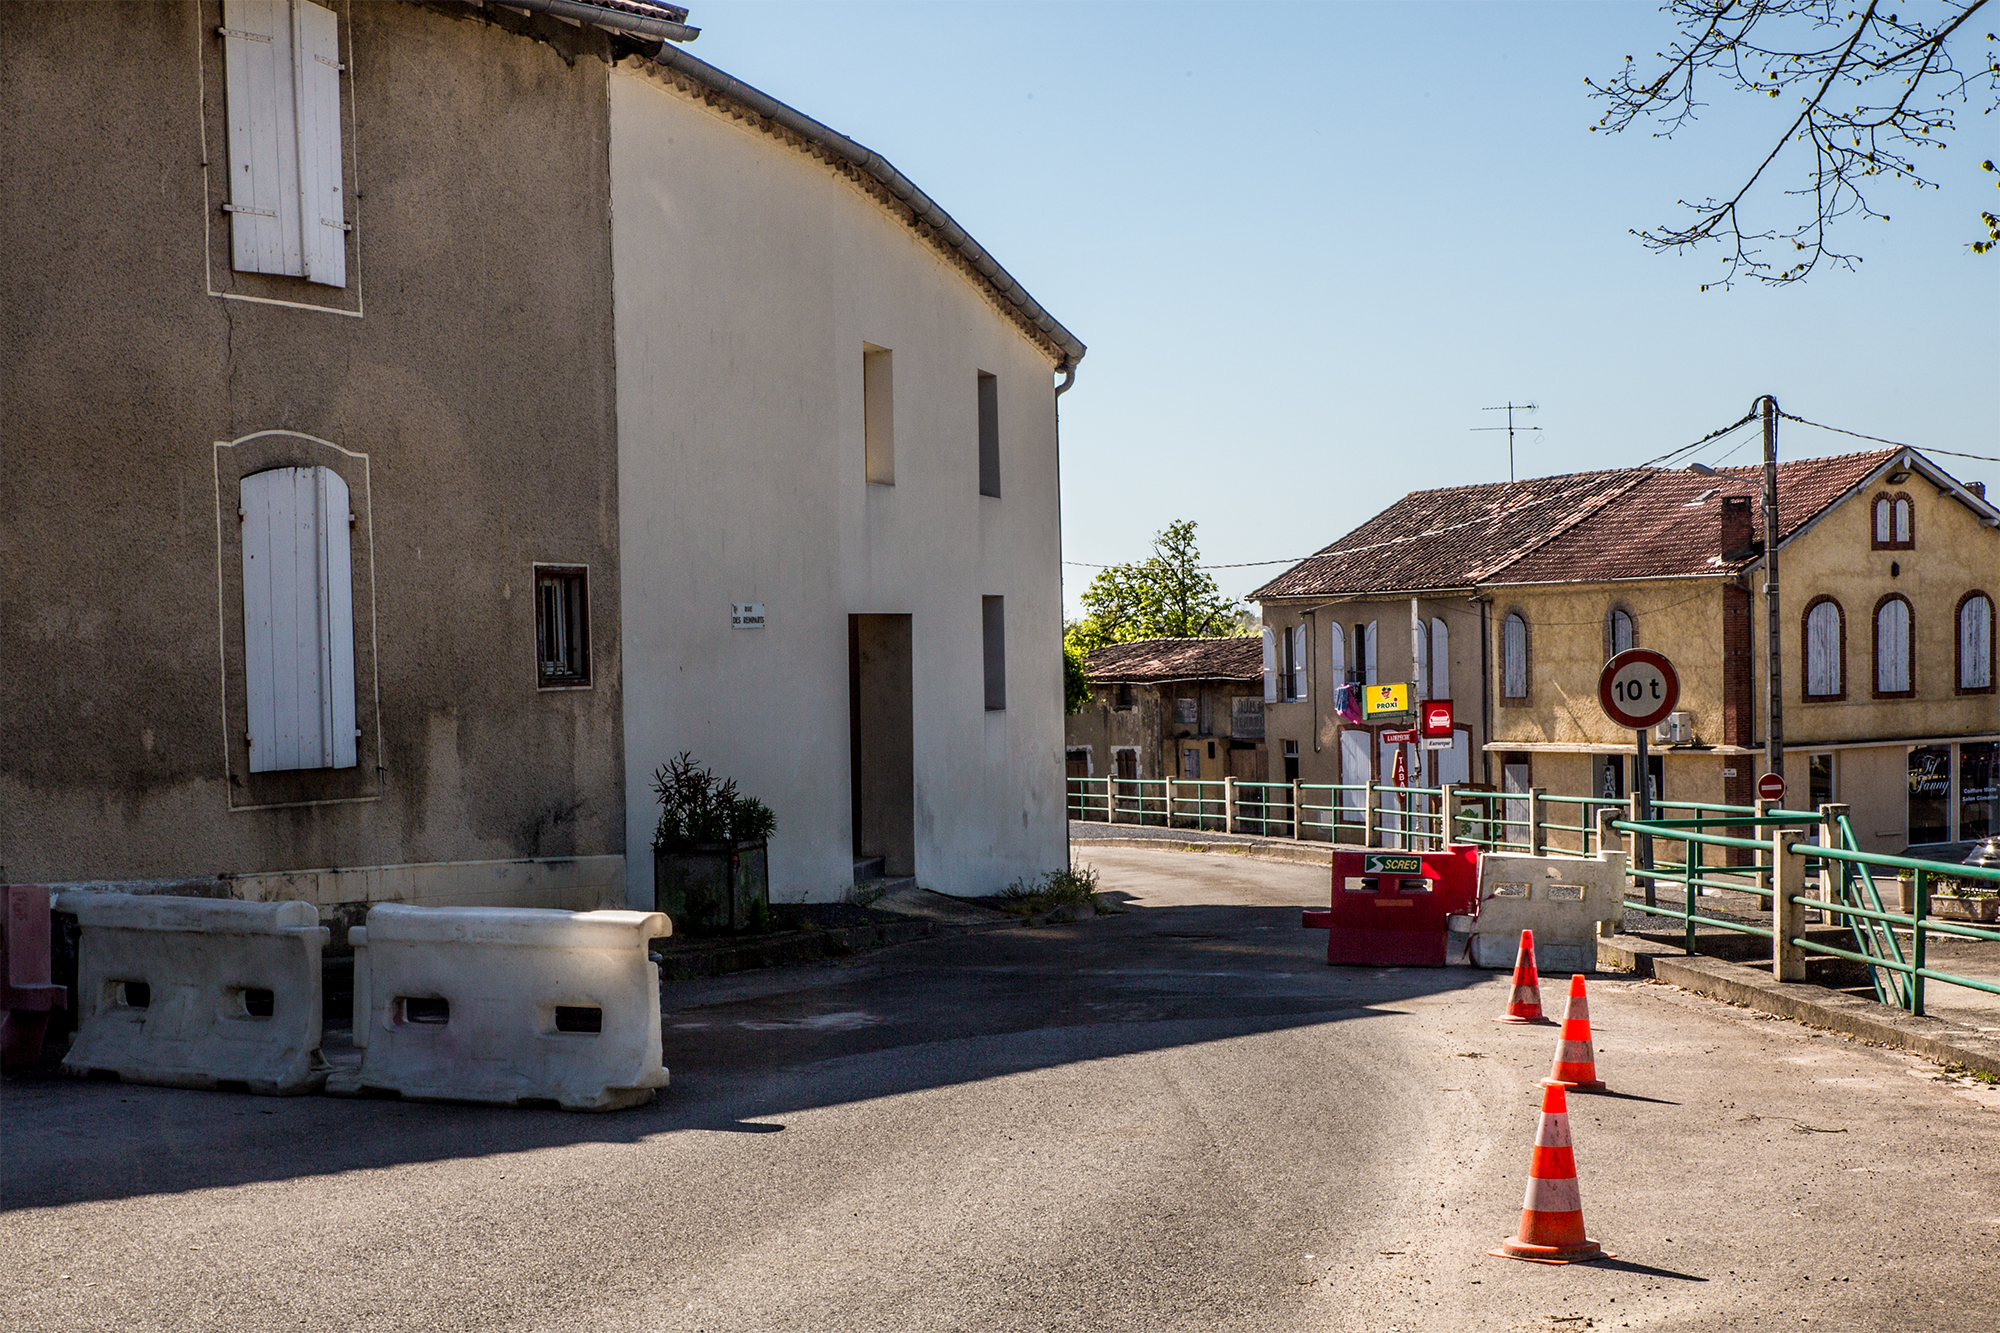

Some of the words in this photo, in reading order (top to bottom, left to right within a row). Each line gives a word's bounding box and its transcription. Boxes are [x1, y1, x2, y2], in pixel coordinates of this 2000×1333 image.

[732, 616, 741, 624] DES
[743, 616, 765, 624] REMPARTS
[1615, 679, 1643, 702] 10
[1649, 678, 1661, 700] t
[1376, 701, 1398, 709] PROXI
[1397, 756, 1406, 797] TABAC
[1908, 775, 1950, 796] Fanny
[1385, 859, 1418, 870] SCREG
